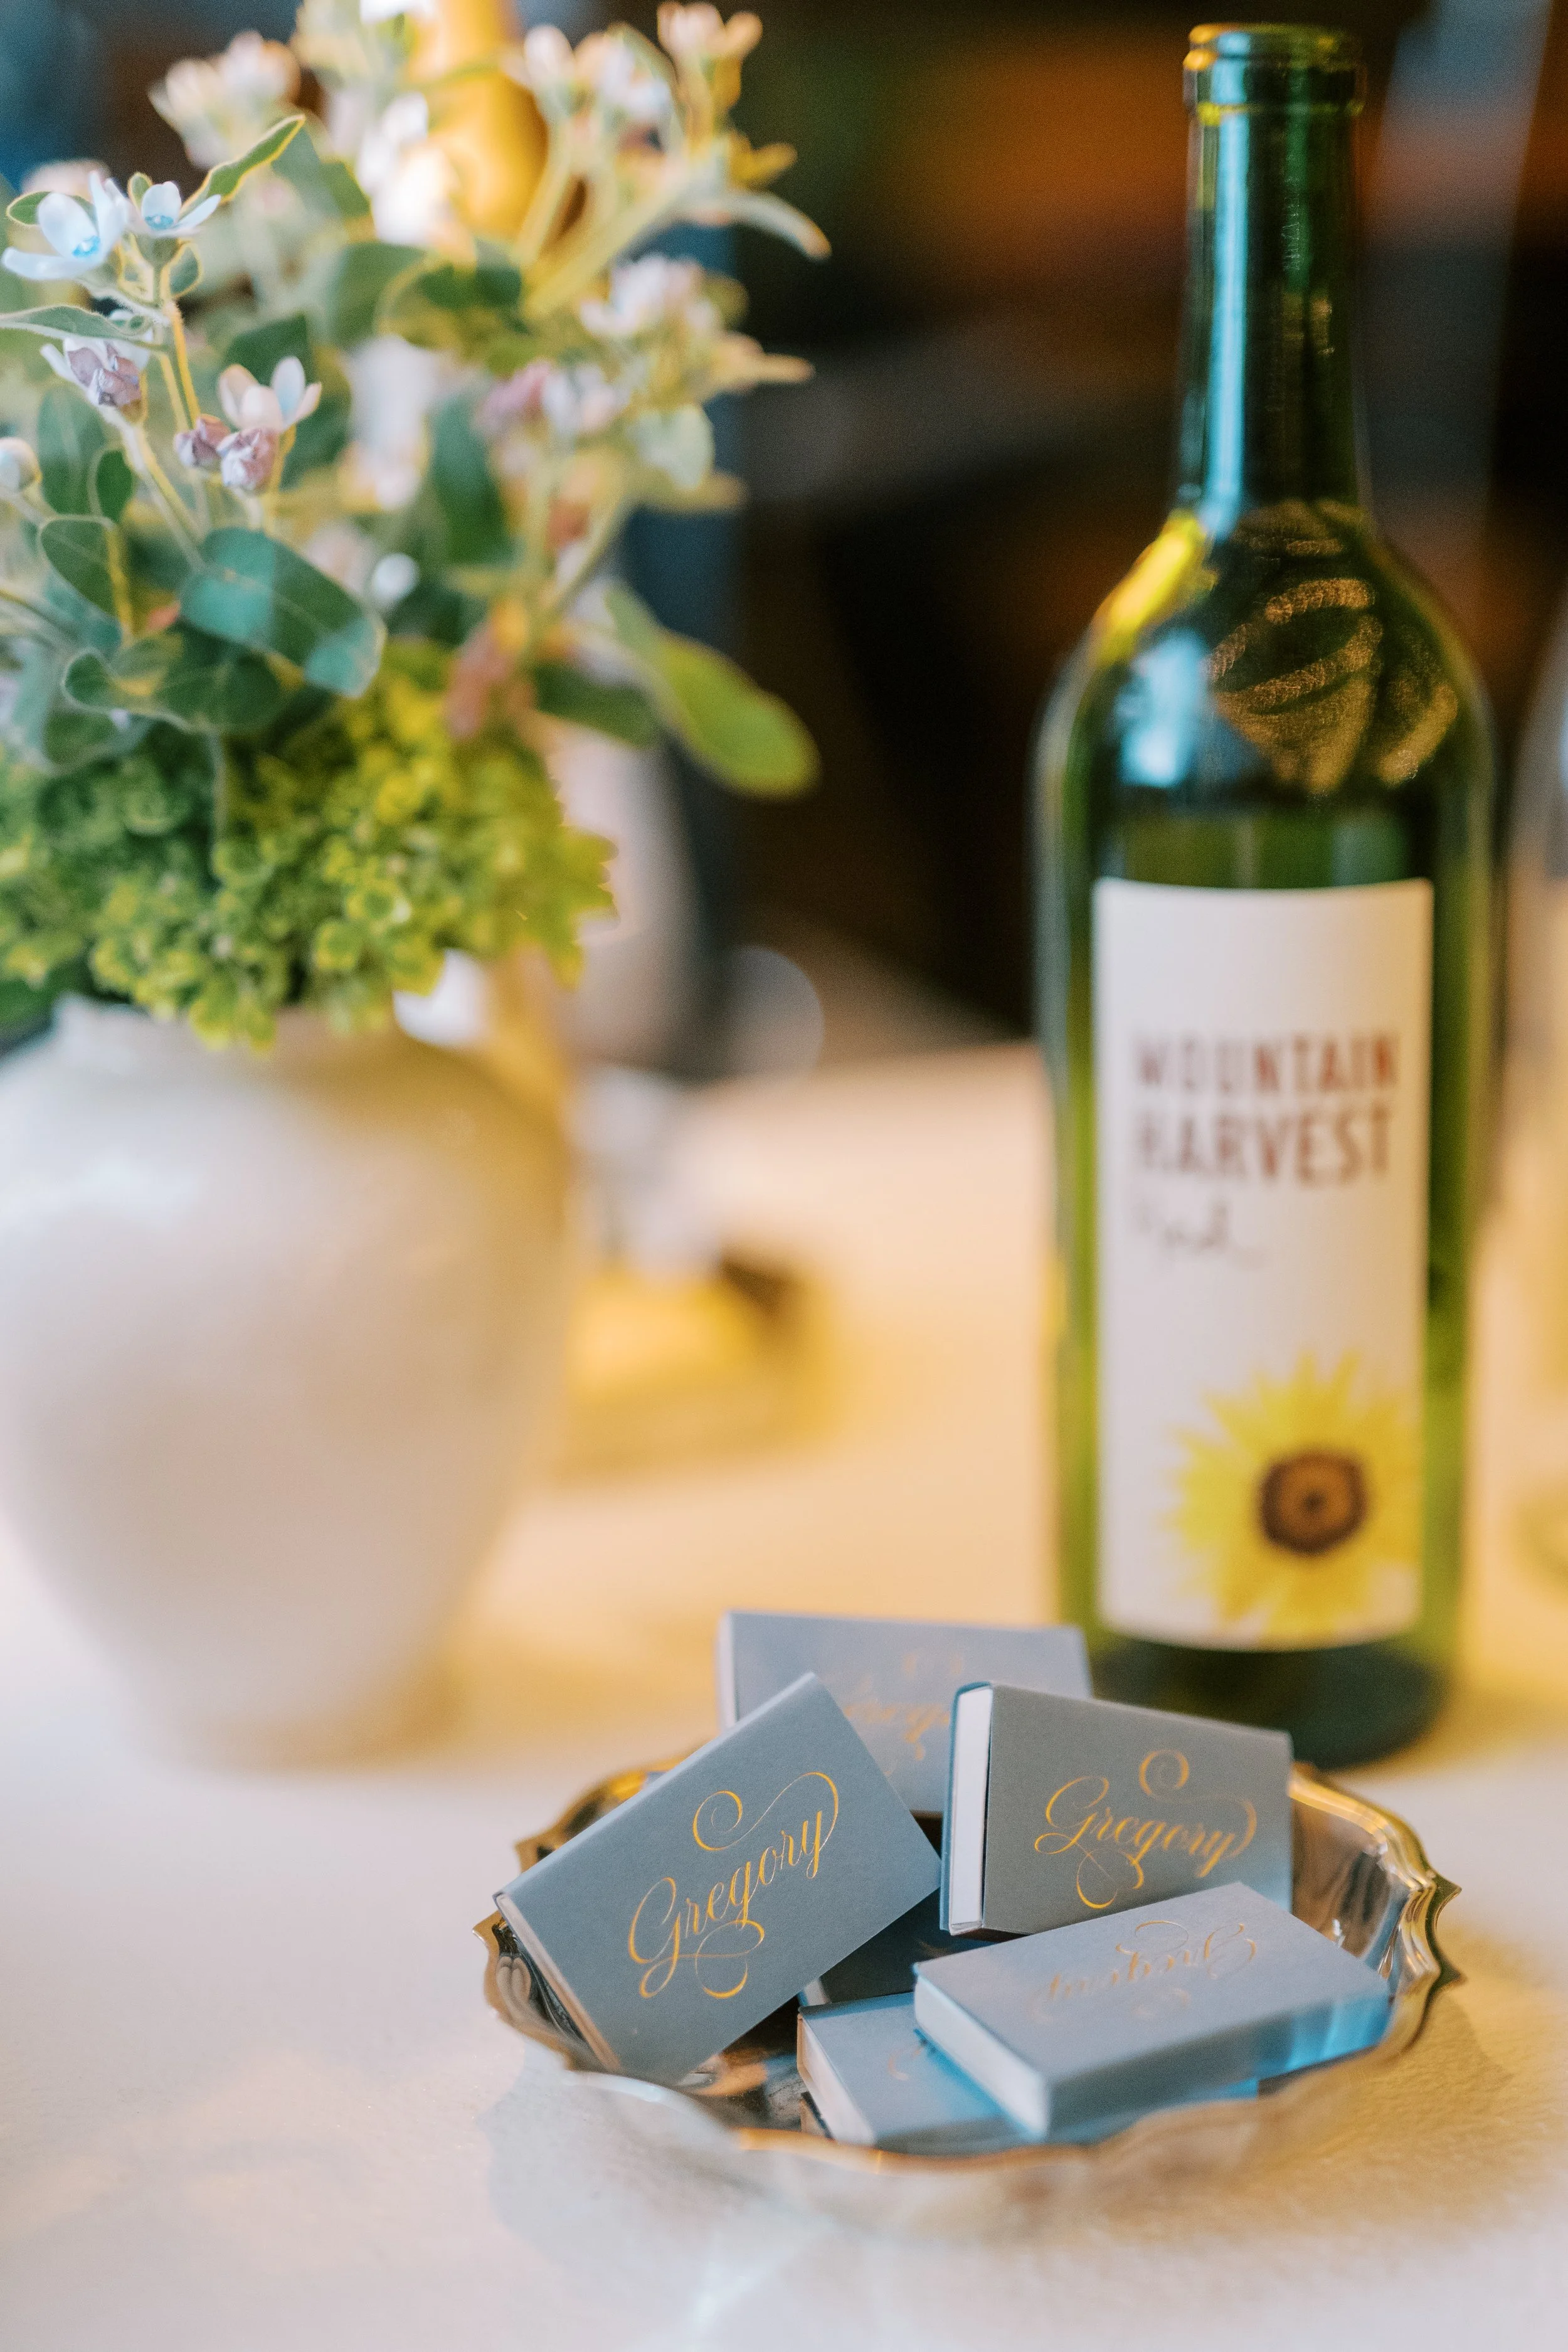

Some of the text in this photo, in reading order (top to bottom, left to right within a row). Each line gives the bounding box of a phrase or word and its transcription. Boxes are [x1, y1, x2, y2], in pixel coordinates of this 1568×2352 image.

[1134, 1030, 1399, 1094] MOUNTAIN
[1136, 1105, 1395, 1185] HARVEST
[628, 1771, 839, 2000] Gregory
[1034, 1749, 1257, 1909] Gregory
